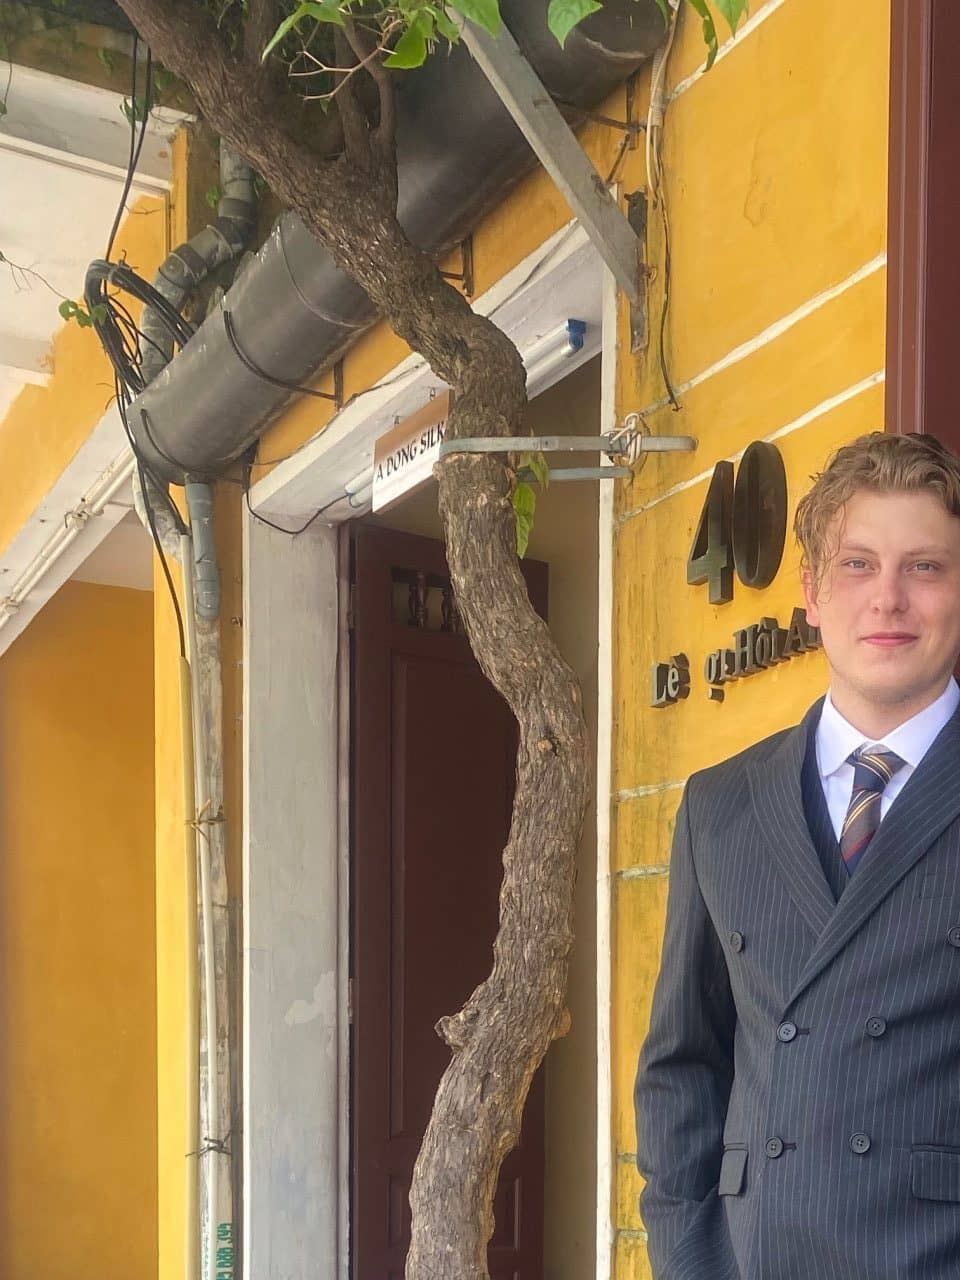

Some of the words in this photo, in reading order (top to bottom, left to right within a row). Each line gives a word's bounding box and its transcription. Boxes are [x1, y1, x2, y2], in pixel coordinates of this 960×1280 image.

[420, 420, 445, 454] SILK
[687, 440, 788, 605] 40
[650, 652, 691, 708] Lê
